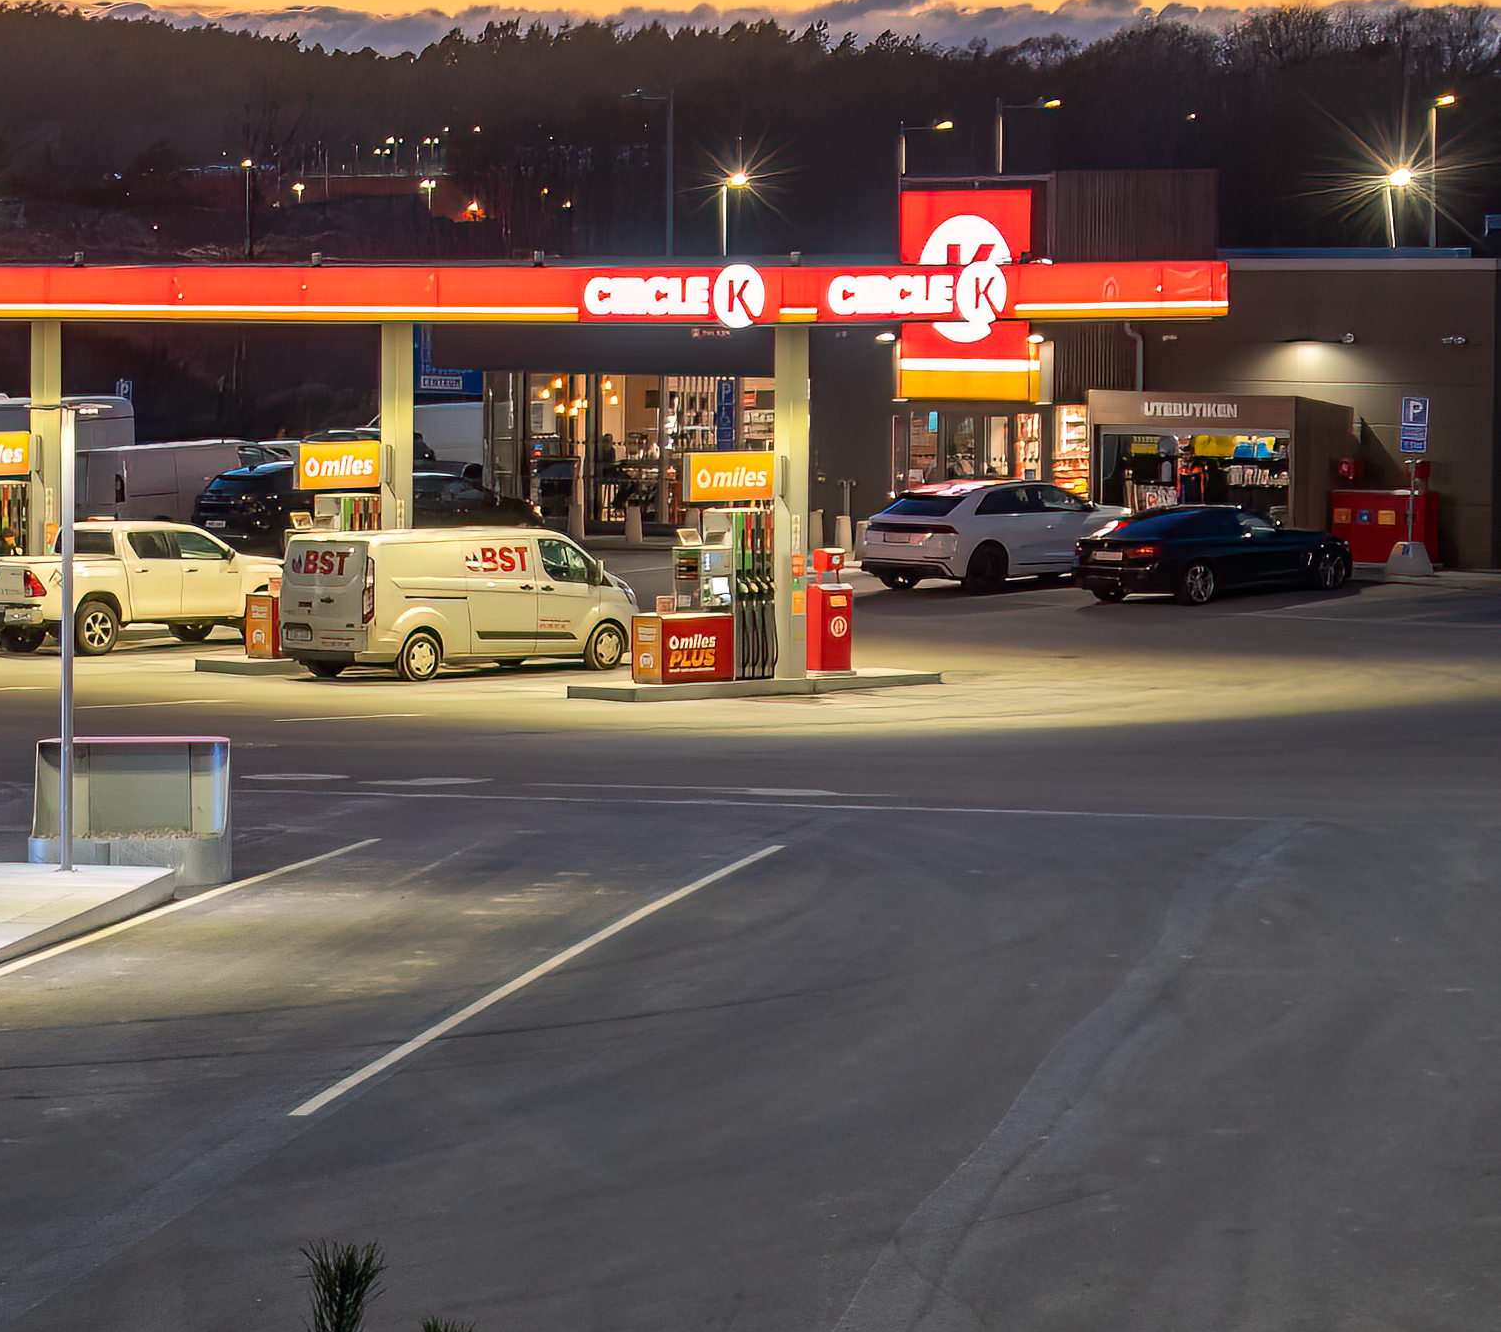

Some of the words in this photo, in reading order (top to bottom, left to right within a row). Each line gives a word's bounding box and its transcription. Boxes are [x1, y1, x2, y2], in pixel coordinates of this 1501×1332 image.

[584, 276, 709, 315] CIRCLE
[828, 275, 954, 315] CIRCLE
[1144, 401, 1238, 418] UTEBUTIKEN
[321, 455, 374, 477] miles
[713, 467, 768, 488] miles
[303, 550, 351, 576] BST
[480, 546, 528, 572] BST
[685, 634, 716, 649] miles
[669, 649, 716, 667] PLUS
